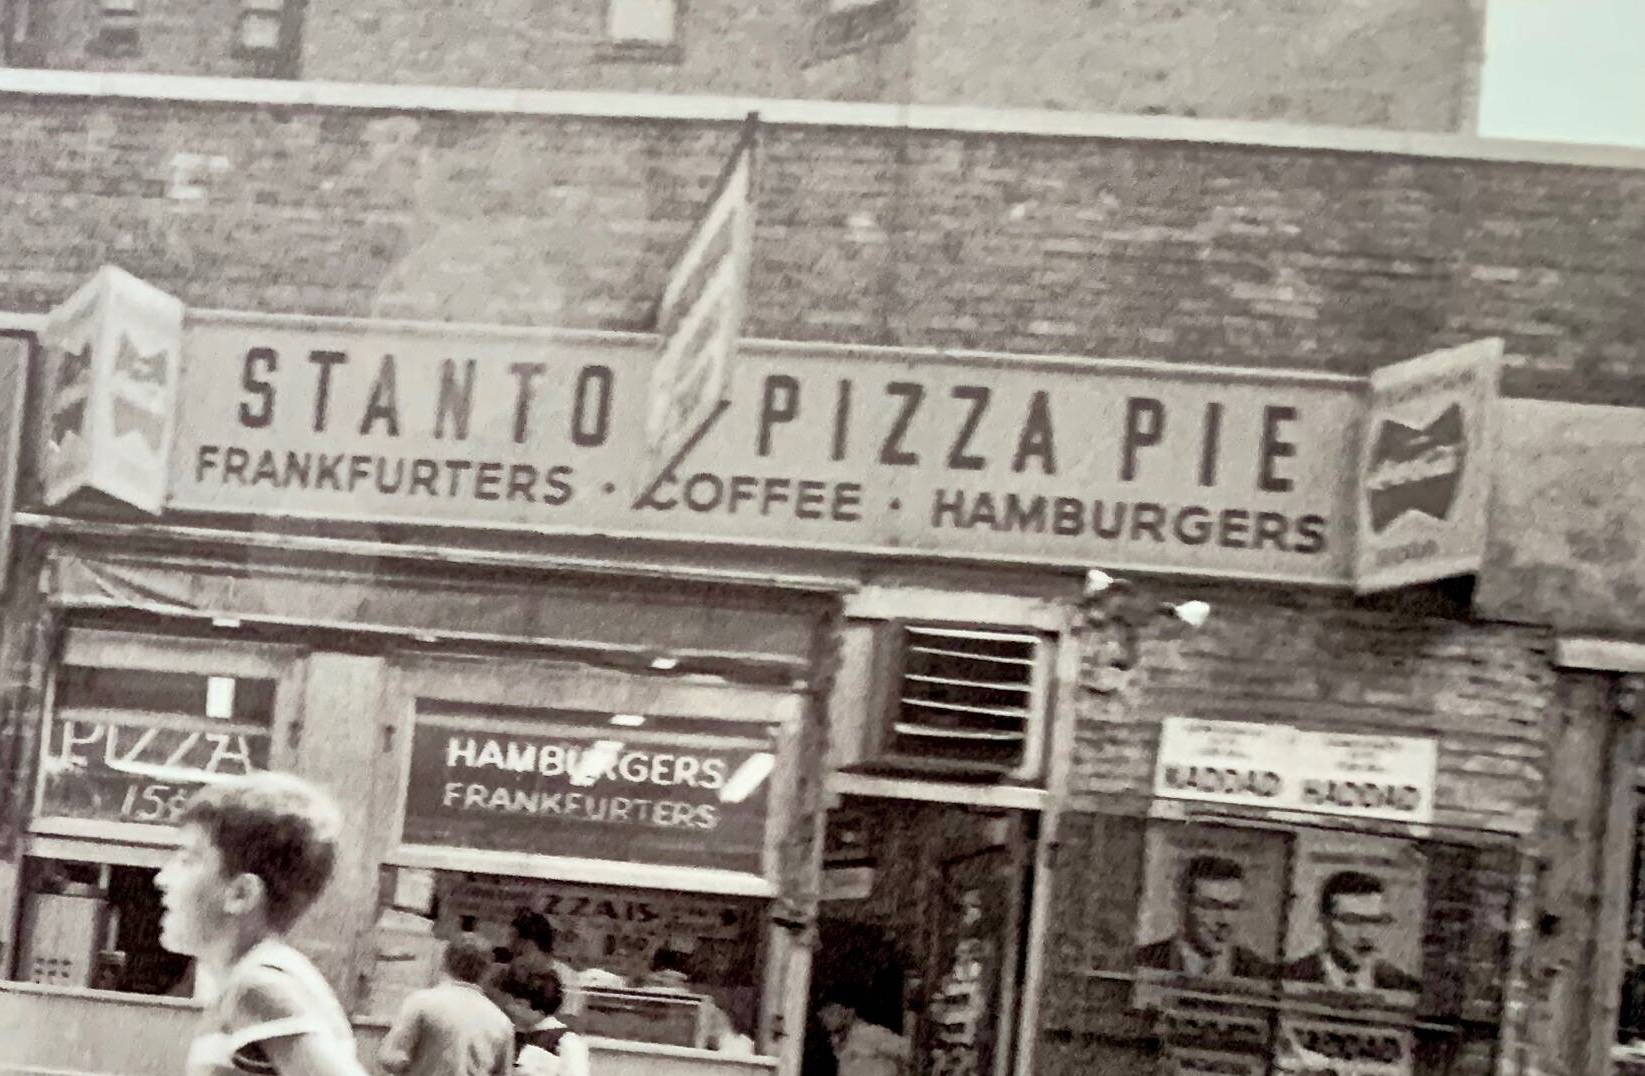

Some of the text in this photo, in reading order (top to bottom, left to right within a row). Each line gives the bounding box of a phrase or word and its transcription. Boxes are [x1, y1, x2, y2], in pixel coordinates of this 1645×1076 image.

[238, 346, 615, 447] STANTO
[756, 374, 1058, 476] PIZZA
[1119, 397, 1299, 493] PIE
[195, 446, 574, 506] FRANKFURTERS
[640, 472, 863, 522] COFFEE
[931, 492, 1328, 555] HAMBURGERS
[61, 720, 252, 776] PIZZA
[443, 781, 720, 829] FRANKFURTERS
